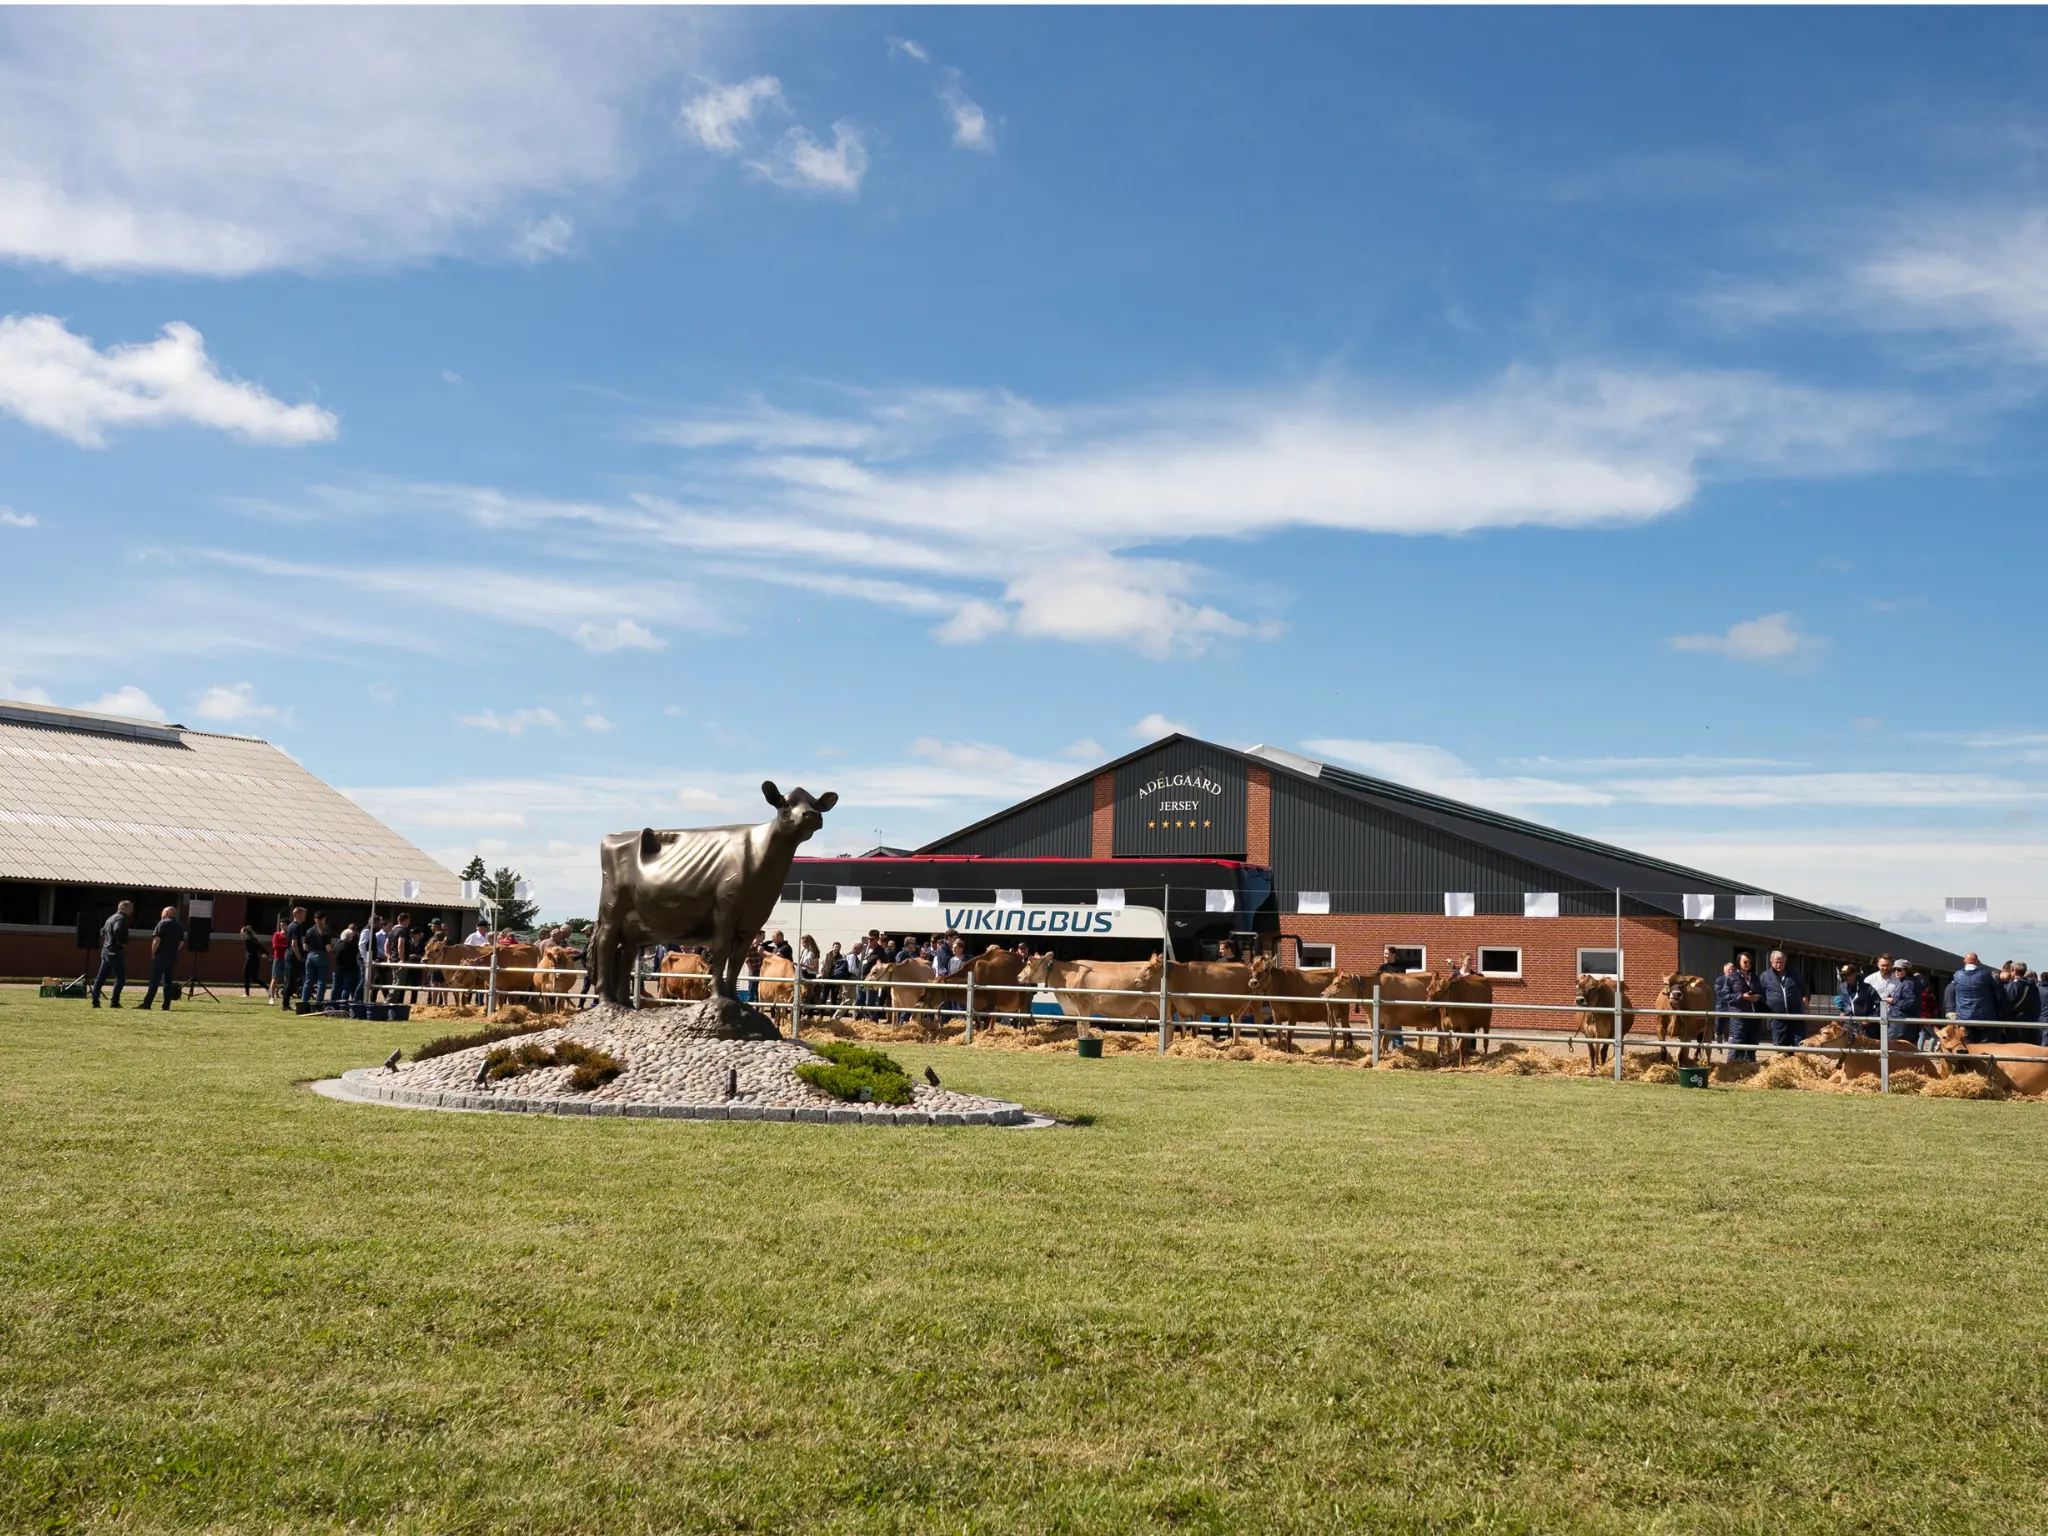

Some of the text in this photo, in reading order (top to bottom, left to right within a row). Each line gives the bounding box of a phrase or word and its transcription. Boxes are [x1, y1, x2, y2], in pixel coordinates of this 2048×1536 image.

[1138, 774, 1222, 799] ADELGAARD
[1159, 800, 1199, 811] JERSEY
[945, 908, 1112, 933] VIKINGBUS
